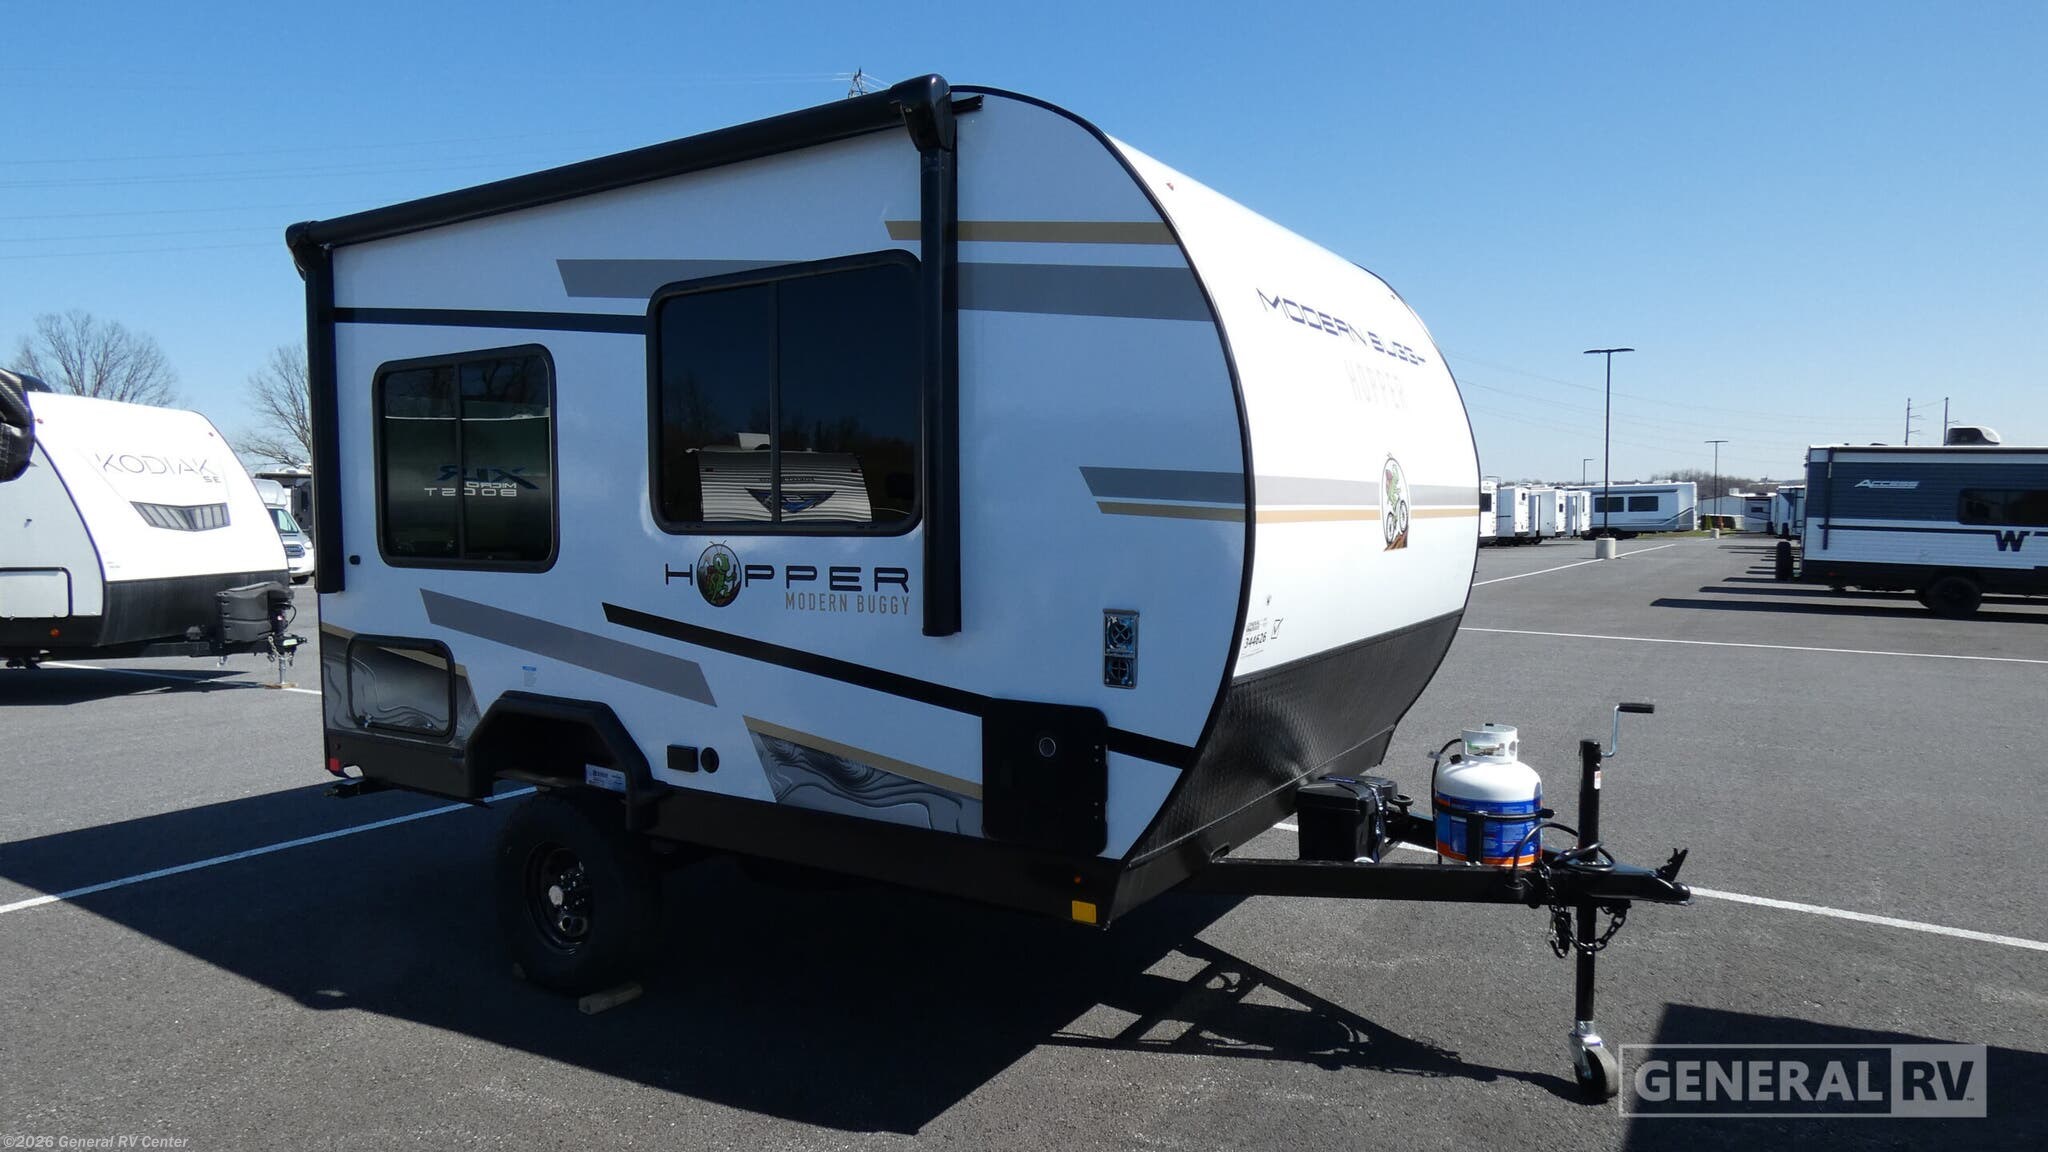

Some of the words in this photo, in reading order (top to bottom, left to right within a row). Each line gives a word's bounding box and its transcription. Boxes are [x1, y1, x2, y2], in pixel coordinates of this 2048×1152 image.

[1256, 287, 1367, 346] MODERN
[1344, 359, 1408, 410] HOPPER
[95, 453, 217, 476] KODIAK
[785, 592, 848, 612] MODERN
[857, 594, 910, 615] BUGGY
[1245, 632, 1267, 648] 344626
